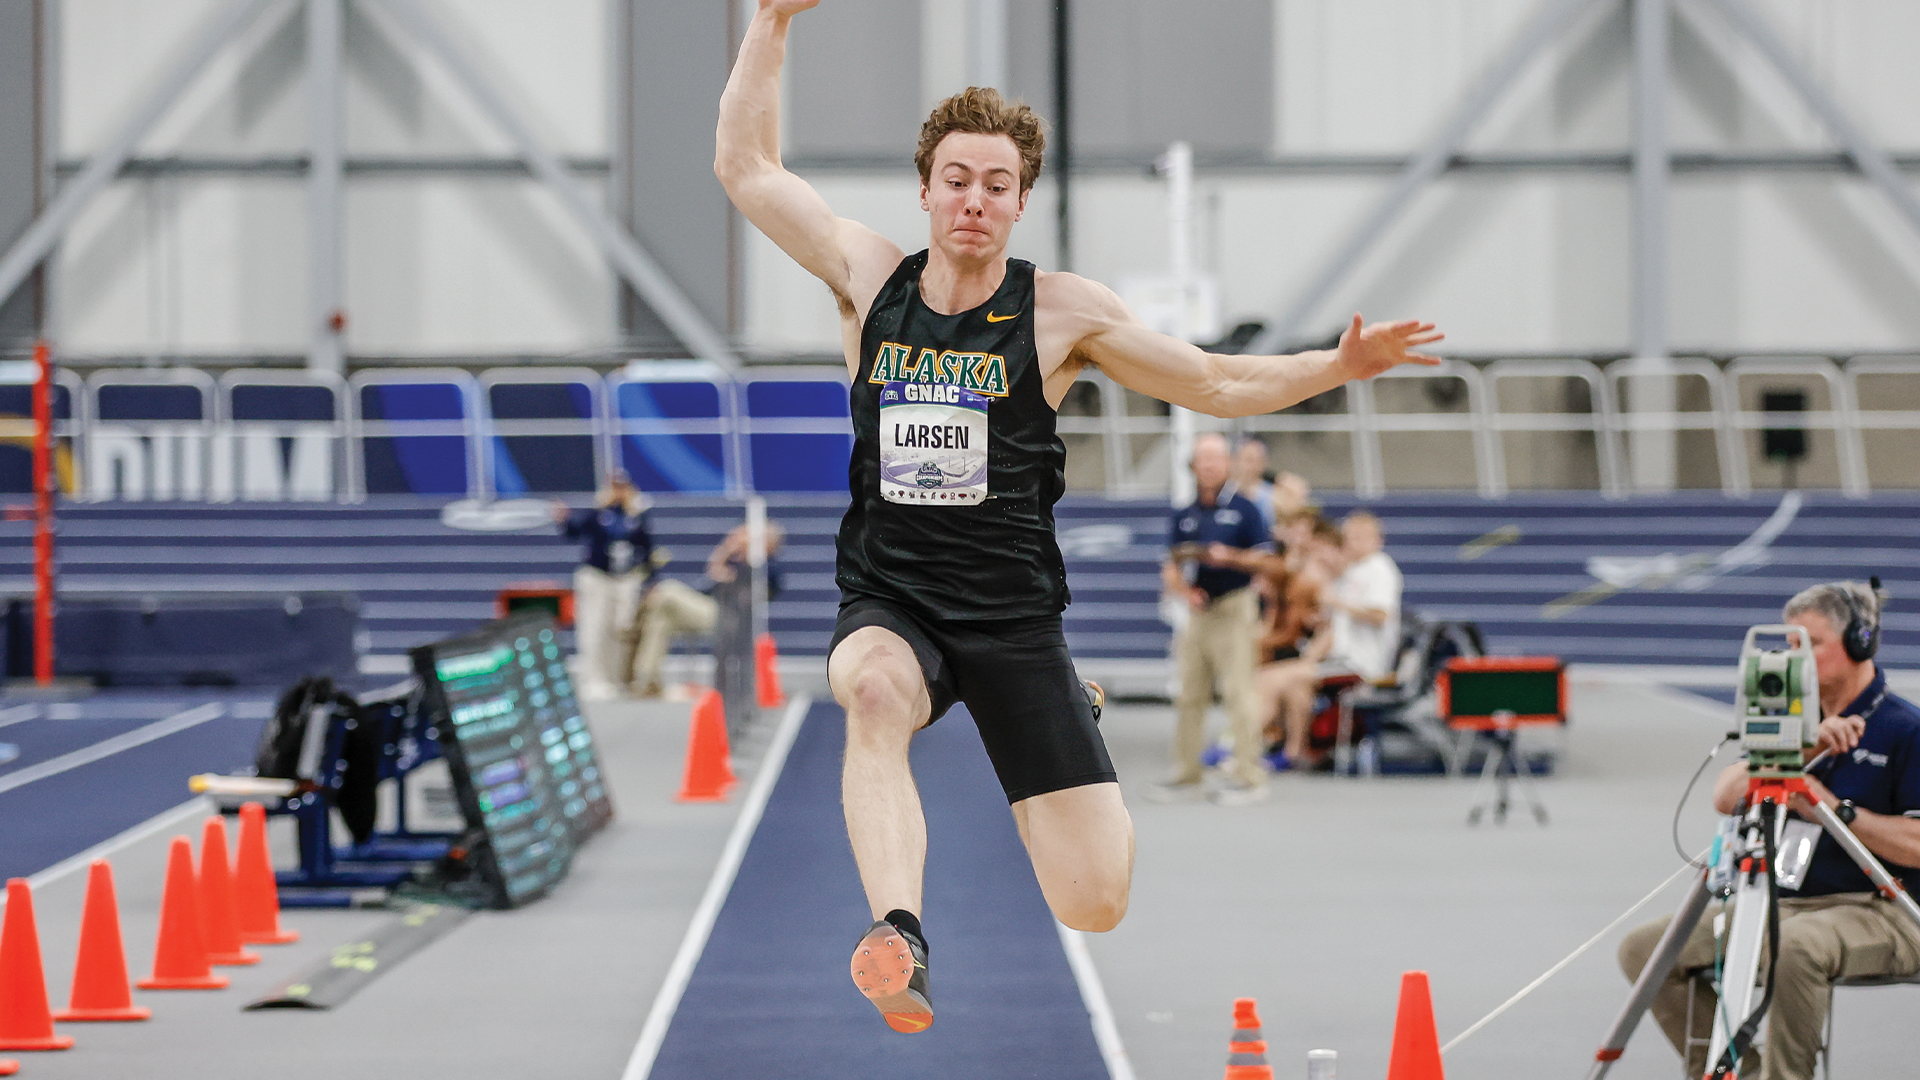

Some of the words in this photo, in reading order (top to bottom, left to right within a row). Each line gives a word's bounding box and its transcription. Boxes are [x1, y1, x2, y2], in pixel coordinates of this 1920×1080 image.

[869, 342, 1009, 397] ALASKA
[904, 383, 961, 403] GNAC
[895, 424, 969, 449] LARSEN
